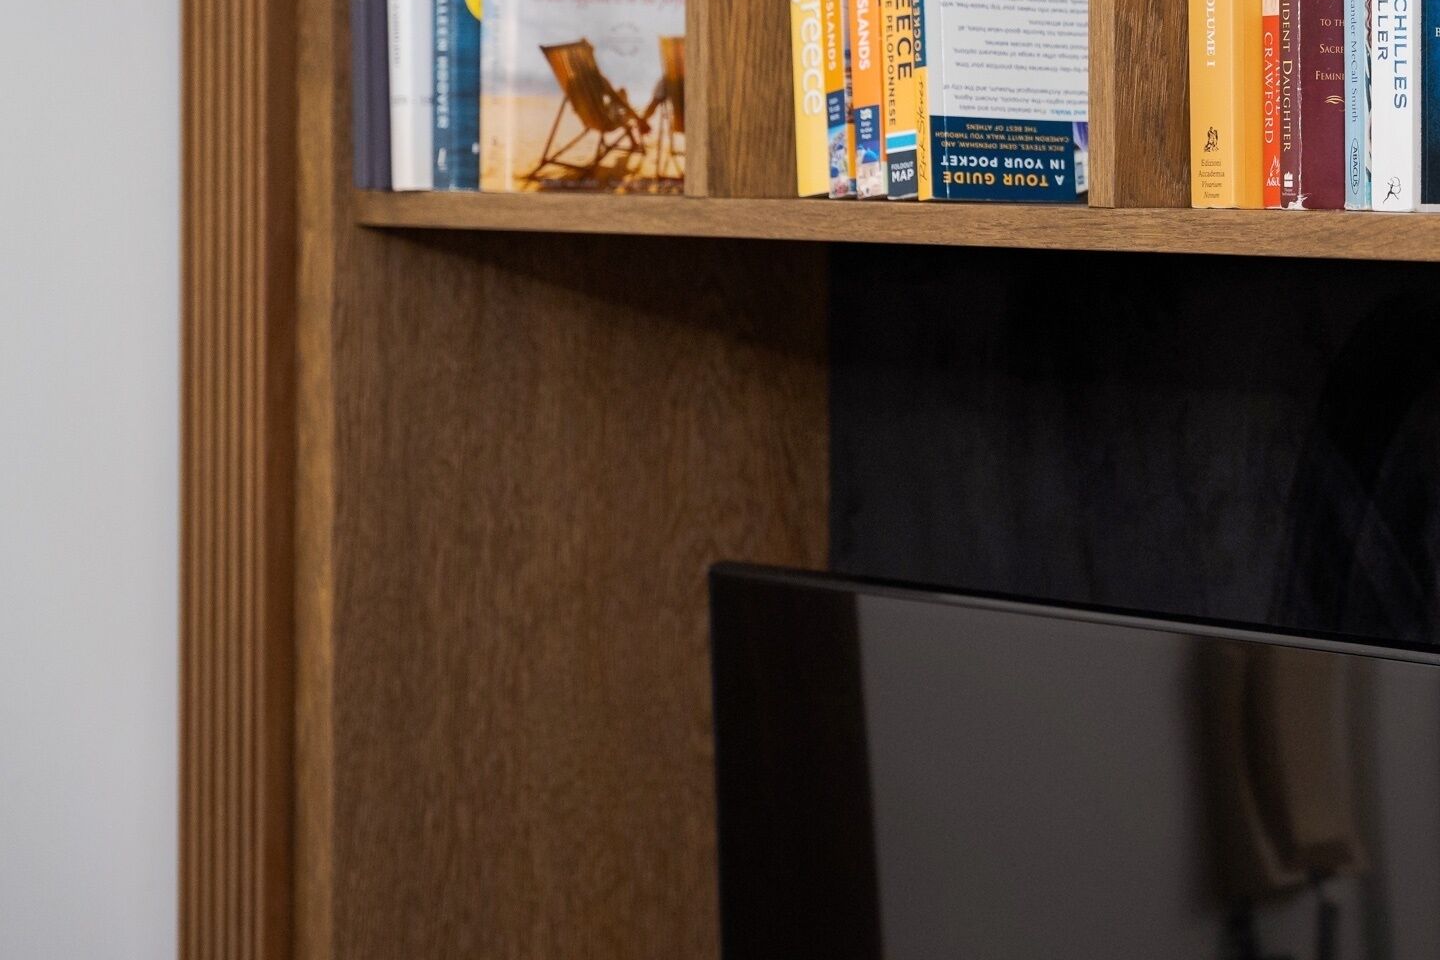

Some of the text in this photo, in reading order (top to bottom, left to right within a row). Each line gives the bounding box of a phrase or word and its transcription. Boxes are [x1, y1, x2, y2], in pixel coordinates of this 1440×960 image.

[1206, 60, 1216, 68] I
[1350, 40, 1358, 84] McCall
[886, 15, 896, 126] PELOPONNESE
[1263, 32, 1274, 144] CRAWFORD
[437, 55, 450, 130] HOOVER
[966, 123, 993, 131] ATHENS
[994, 124, 1004, 132] OF
[1006, 124, 1022, 132] BEST
[935, 131, 968, 139] THROUGH
[970, 132, 984, 140] YOU
[986, 132, 1005, 140] WALK
[940, 140, 956, 148] AND
[1048, 144, 1064, 152] RICK
[940, 155, 1065, 170] IN YOUR POCKET
[891, 168, 914, 183] MAP
[942, 170, 1064, 188] A TOUR GUIDE
